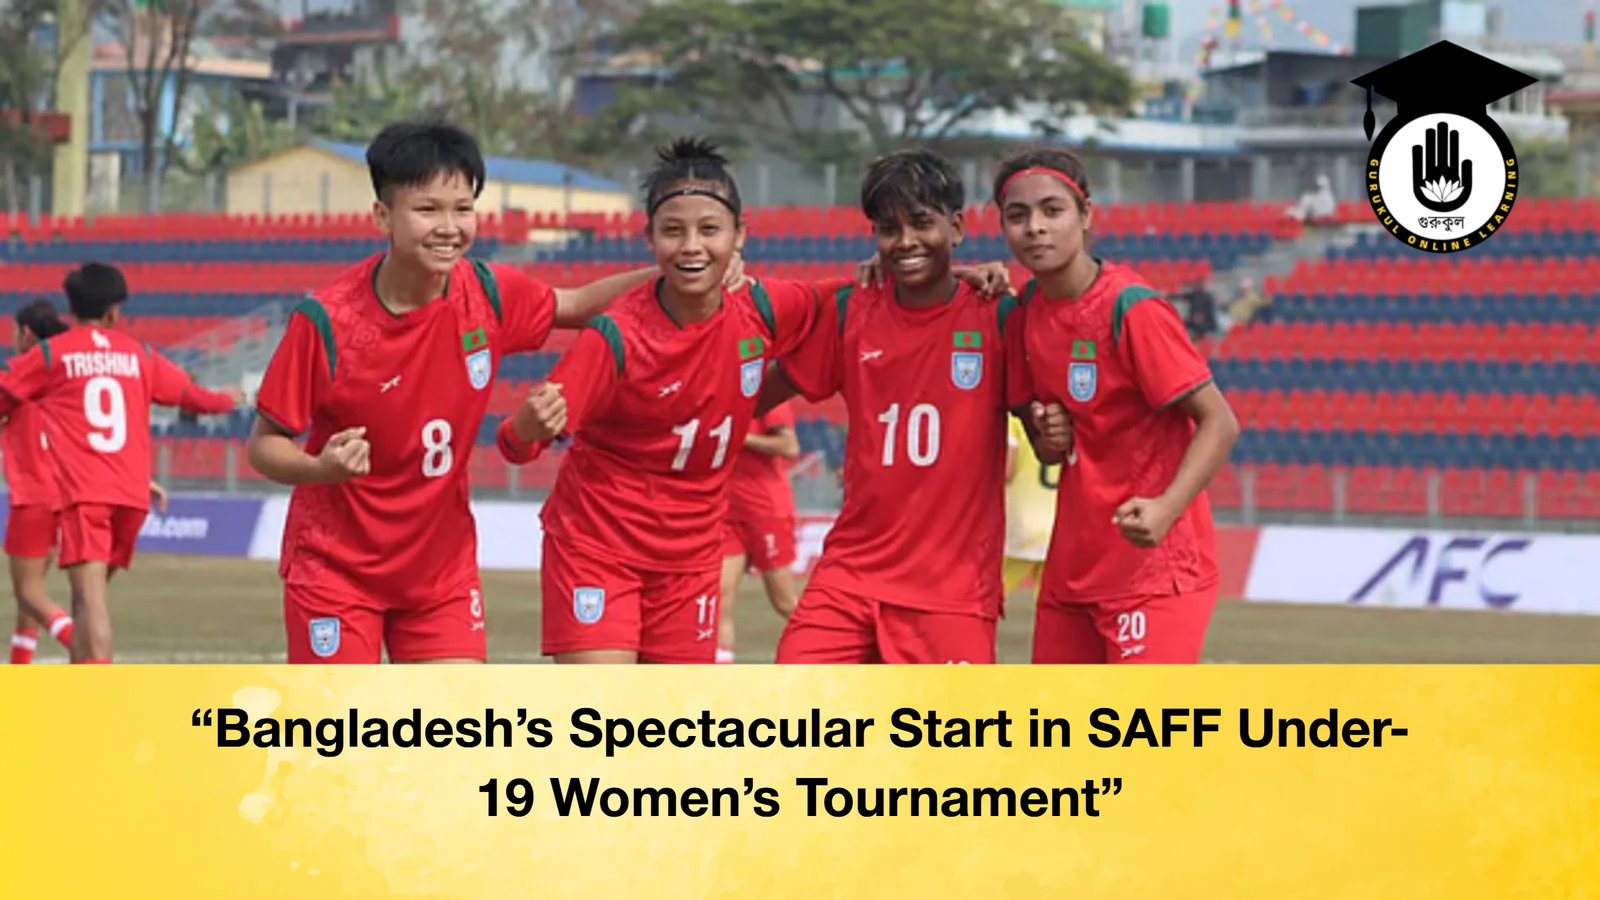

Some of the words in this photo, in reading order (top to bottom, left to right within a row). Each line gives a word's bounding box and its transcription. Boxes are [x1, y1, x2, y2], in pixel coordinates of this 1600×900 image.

[61, 351, 140, 378] TRISHNA
[84, 377, 127, 453] 9
[670, 415, 732, 471] 11
[878, 403, 940, 466] 10
[421, 419, 453, 477] 8
[1350, 536, 1533, 606] AFC
[696, 594, 717, 624] 11
[1117, 611, 1146, 641] 20
